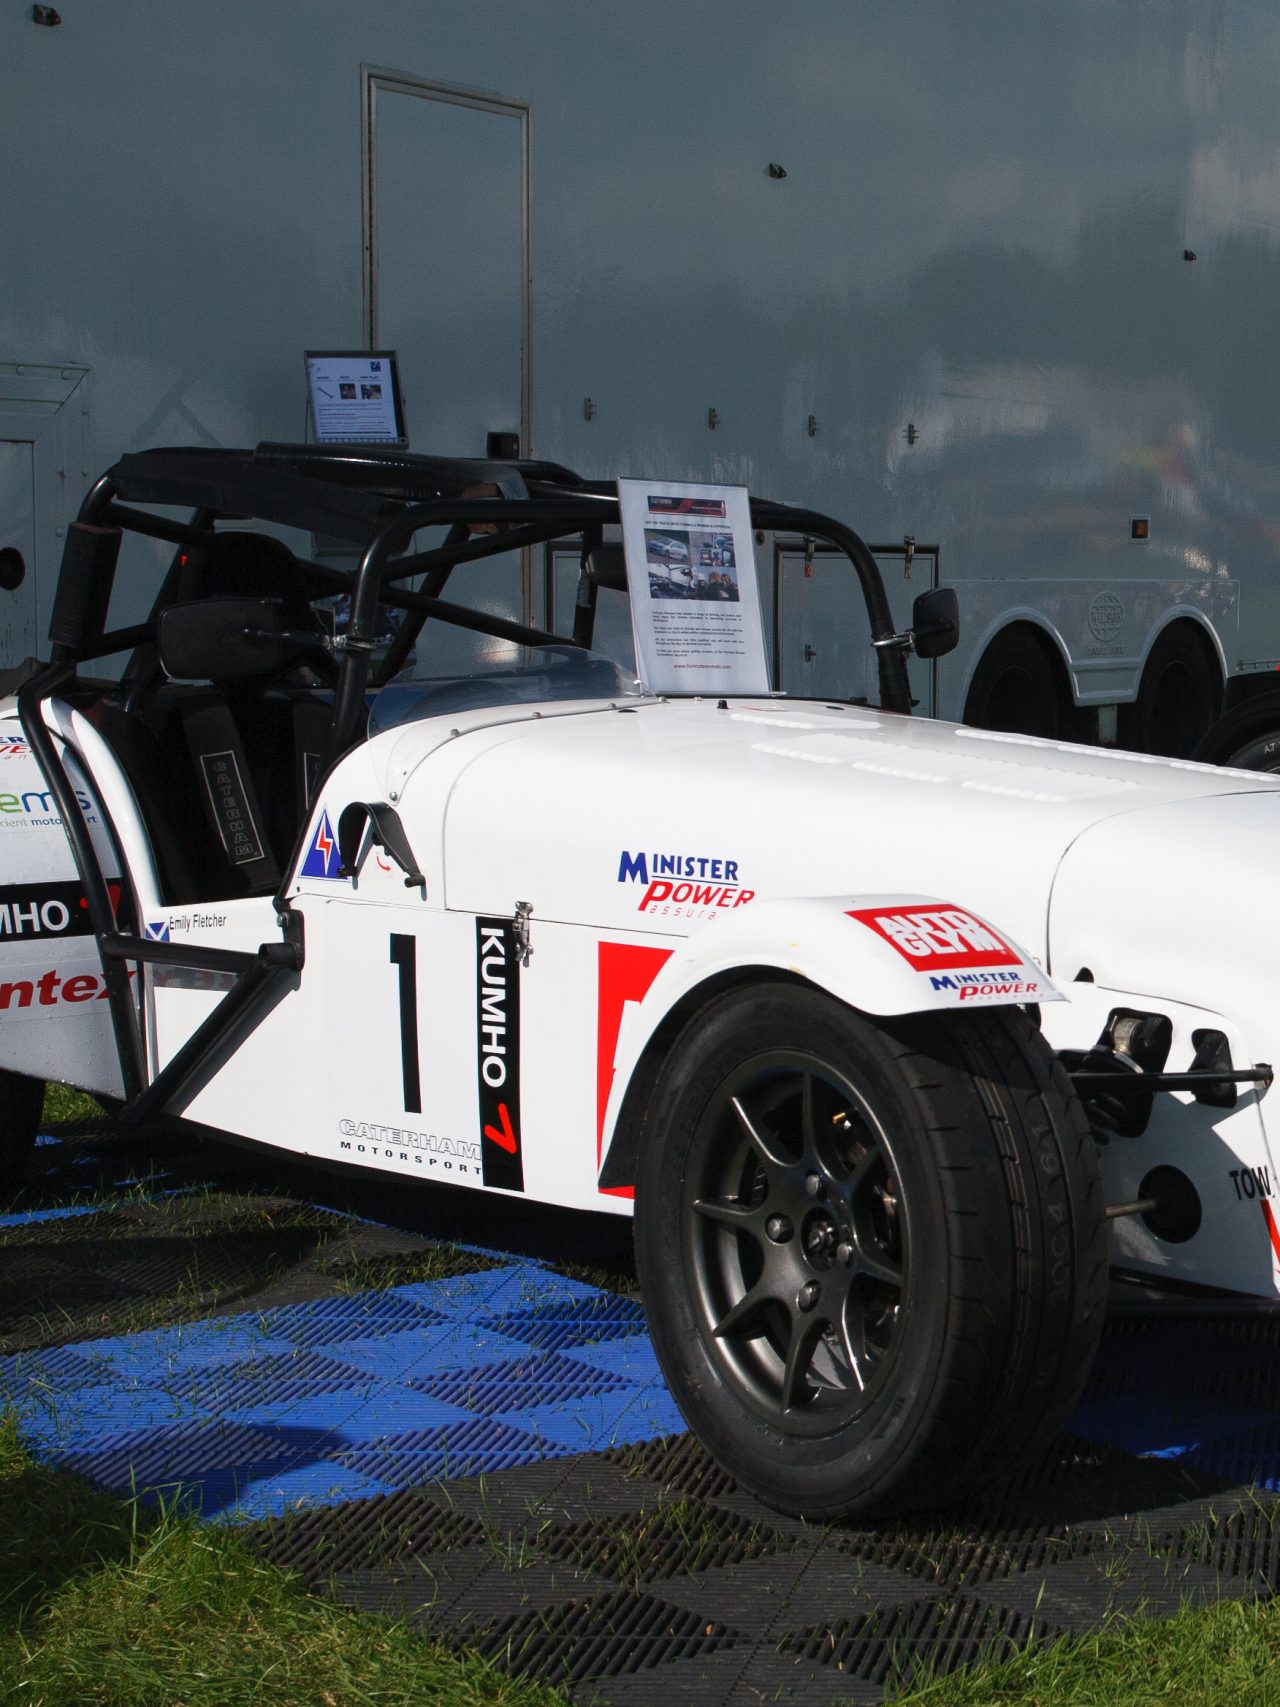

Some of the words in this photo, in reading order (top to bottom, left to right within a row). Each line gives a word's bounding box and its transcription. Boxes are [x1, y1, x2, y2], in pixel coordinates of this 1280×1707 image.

[618, 851, 738, 884] MINISTER
[637, 880, 755, 912] POWER
[169, 914, 191, 932] Emily
[193, 914, 227, 929] Fletcher
[874, 911, 982, 936] AUTO
[891, 928, 1004, 957] GLYM
[930, 972, 1021, 991] MINISTER
[959, 983, 1038, 1000] POWER
[390, 933, 422, 1114] 1
[481, 927, 507, 1088] KUMHO
[338, 1118, 482, 1161] CATERHAM
[340, 1141, 482, 1175] MOTORSPORT
